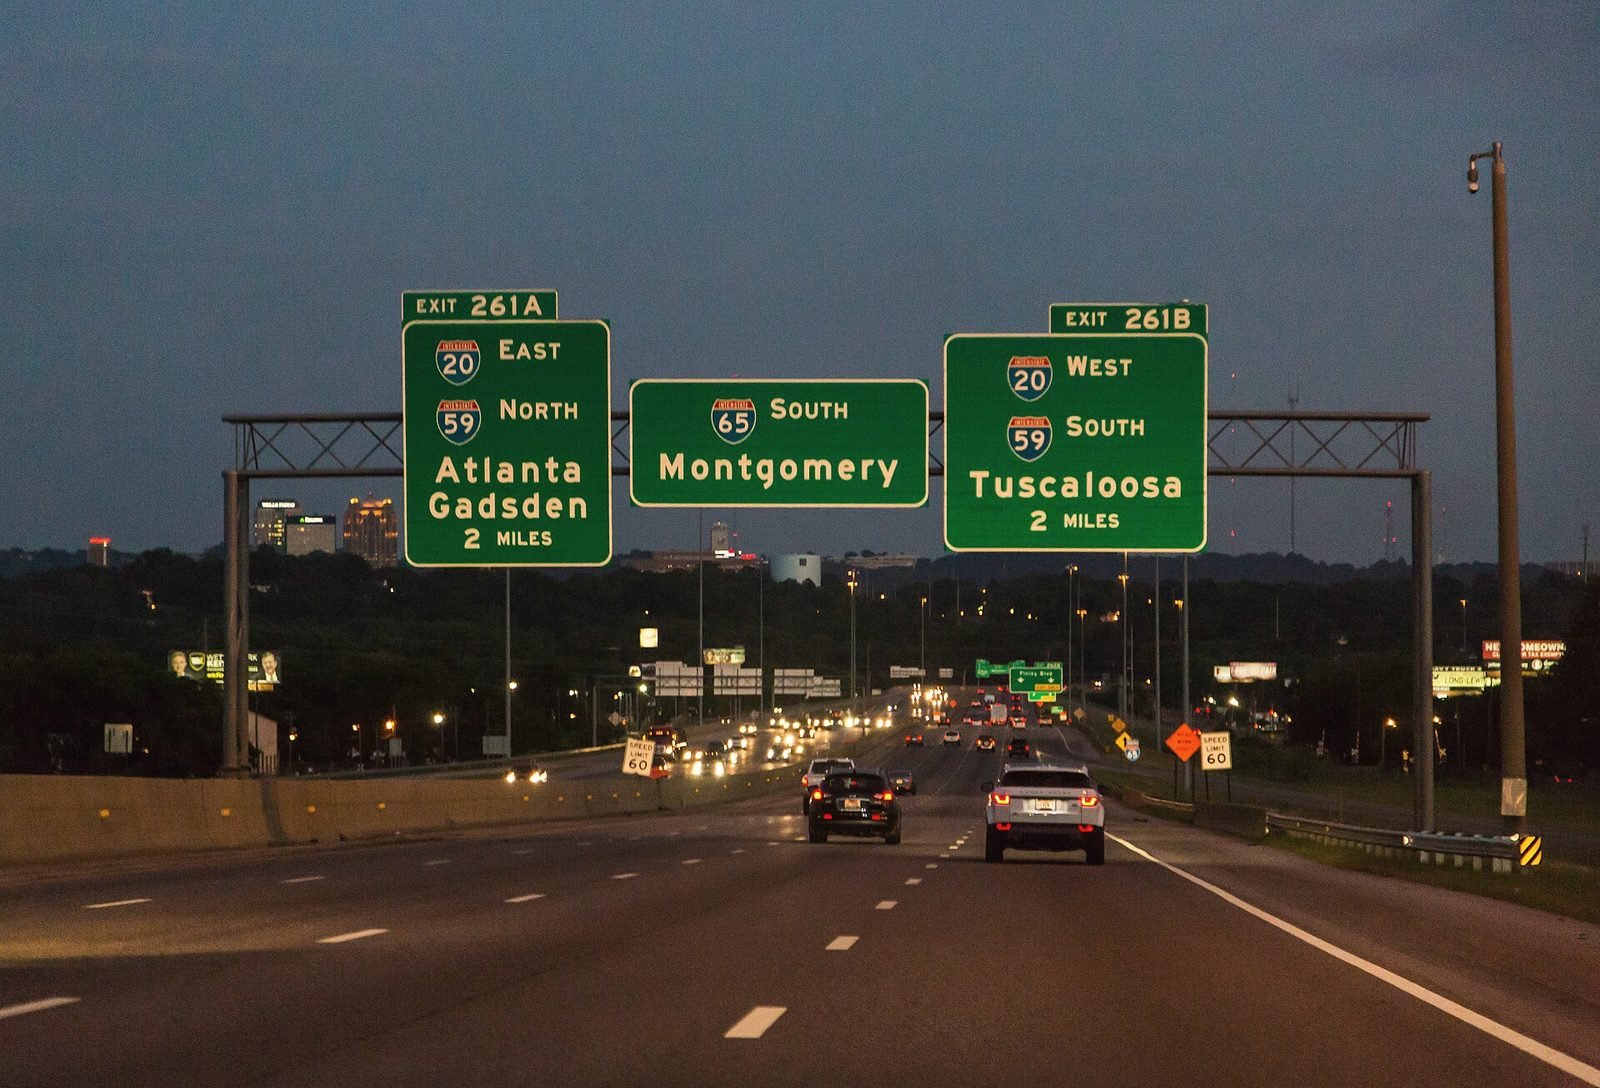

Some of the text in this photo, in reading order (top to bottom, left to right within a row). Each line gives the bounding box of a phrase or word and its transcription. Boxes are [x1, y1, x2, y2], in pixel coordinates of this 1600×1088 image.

[416, 294, 542, 316] EXIT 261A
[1066, 308, 1191, 329] EXIT 261B
[499, 339, 561, 360] EAST
[443, 353, 474, 375] 20
[1067, 355, 1132, 376] WEST
[1014, 369, 1046, 391] 20
[500, 398, 578, 420] NORTH
[770, 398, 848, 420] SOUTH
[444, 413, 474, 434] 59
[718, 412, 749, 433] 65
[1066, 415, 1145, 437] SOUTH
[1014, 429, 1045, 451] 59
[435, 456, 581, 484] Atlanta
[659, 453, 898, 490] Montgomery
[969, 470, 1182, 498] Tuscaloosa
[428, 491, 587, 519] Gadsden
[1030, 510, 1120, 531] 2 MILES
[464, 528, 552, 549] 2 MILES
[629, 742, 653, 751] SPEED
[1203, 736, 1228, 744] SPEED
[628, 759, 648, 770] 60
[630, 751, 648, 759] LIMIT
[1207, 752, 1226, 764] 60
